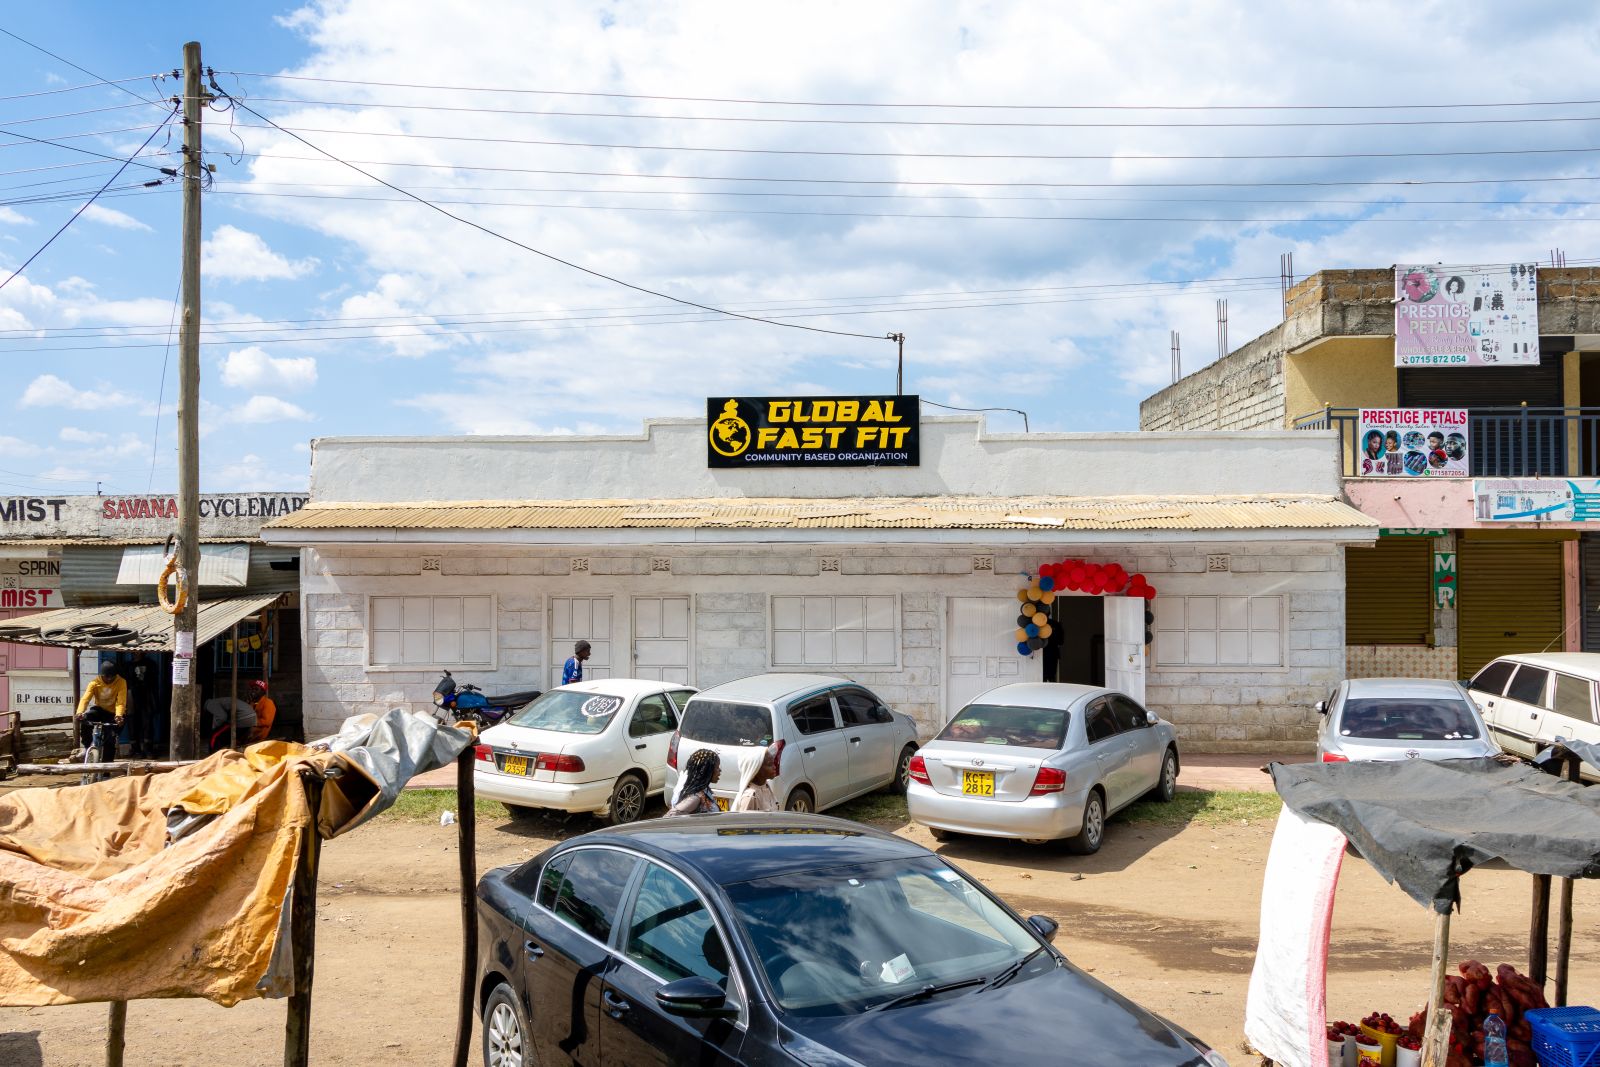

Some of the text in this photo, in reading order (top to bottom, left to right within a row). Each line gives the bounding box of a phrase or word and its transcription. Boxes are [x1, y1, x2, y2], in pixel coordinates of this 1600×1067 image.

[1399, 303, 1471, 319] PRESTIGE
[1409, 319, 1468, 334] PETALS
[1410, 355, 1466, 364] 0715 872 054
[768, 400, 903, 423] GLOBAL
[1362, 410, 1467, 425] PRESTIGE PETALS
[757, 427, 911, 449] FAST FIT
[745, 452, 908, 461] COMMUNITY BASED ORGANIZATION
[102, 498, 179, 519] SAVANA
[19, 561, 60, 575] SPRIN
[1, 589, 53, 607] MIST
[16, 693, 31, 703] B.P
[34, 695, 62, 704] CHECK
[965, 771, 986, 783] KCT
